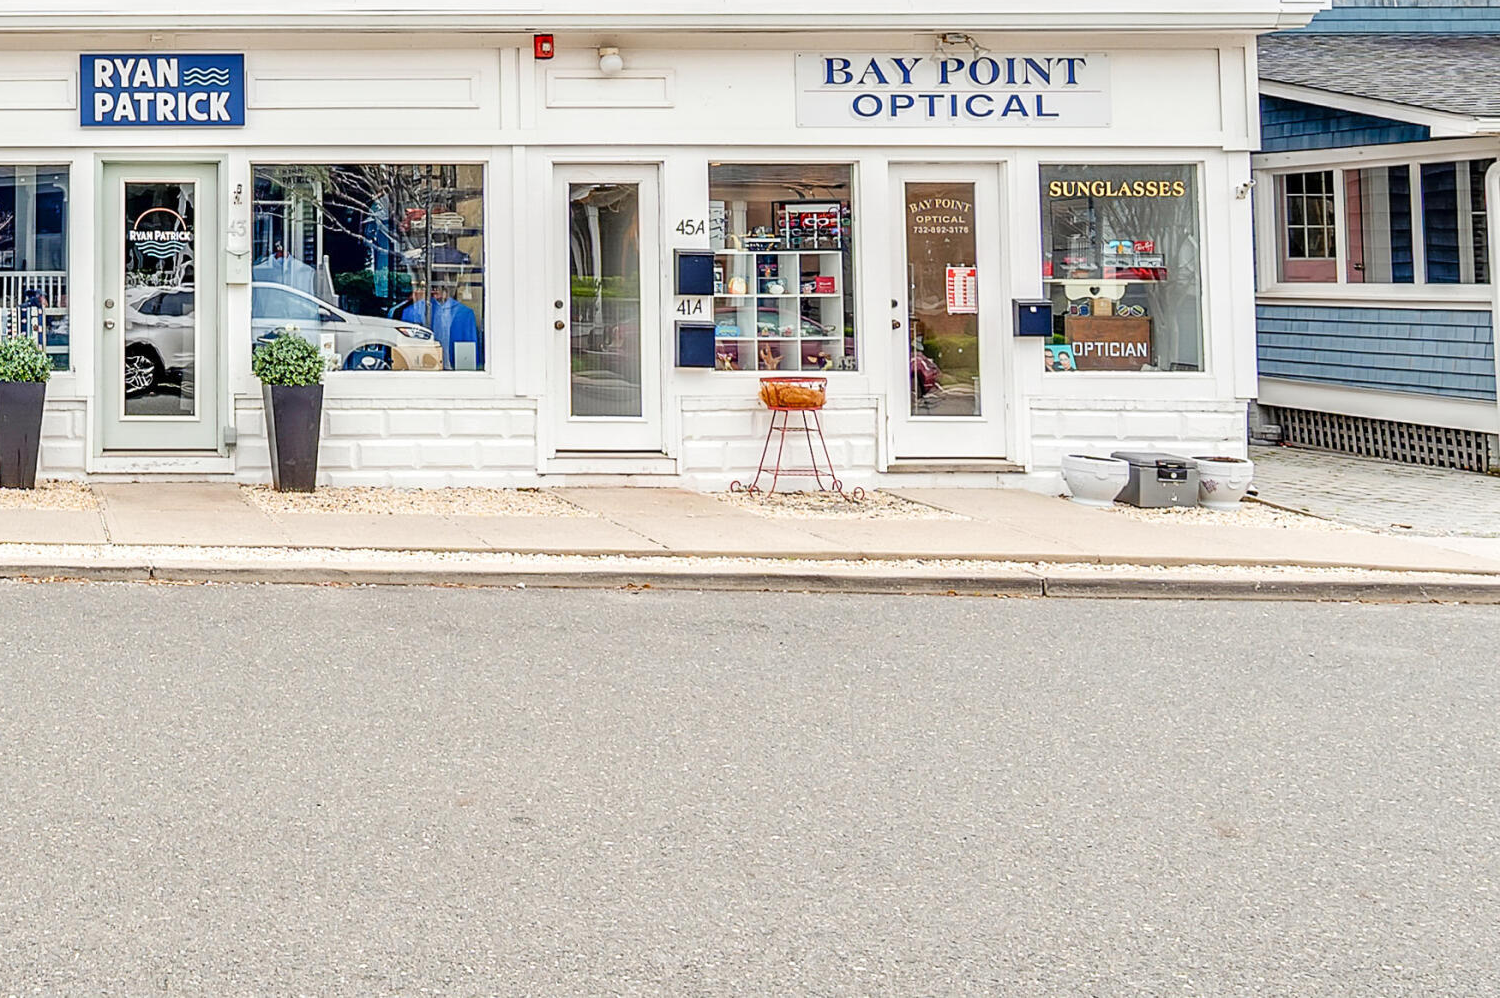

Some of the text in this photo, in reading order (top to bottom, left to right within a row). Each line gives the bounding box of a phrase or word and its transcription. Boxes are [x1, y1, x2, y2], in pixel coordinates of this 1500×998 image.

[94, 58, 179, 88] RYAN
[823, 56, 1087, 86] BAY POINT
[94, 92, 231, 122] PATRICK
[852, 93, 1060, 118] OPTICAL
[1049, 180, 1186, 198] SUNGLASSES
[909, 198, 972, 214] BAY POINT
[676, 219, 705, 235] 45A
[916, 215, 966, 224] OPTICAL
[130, 230, 191, 241] RYAN PATRICK
[677, 299, 703, 315] 41A
[1072, 342, 1148, 357] OPTICIAN
